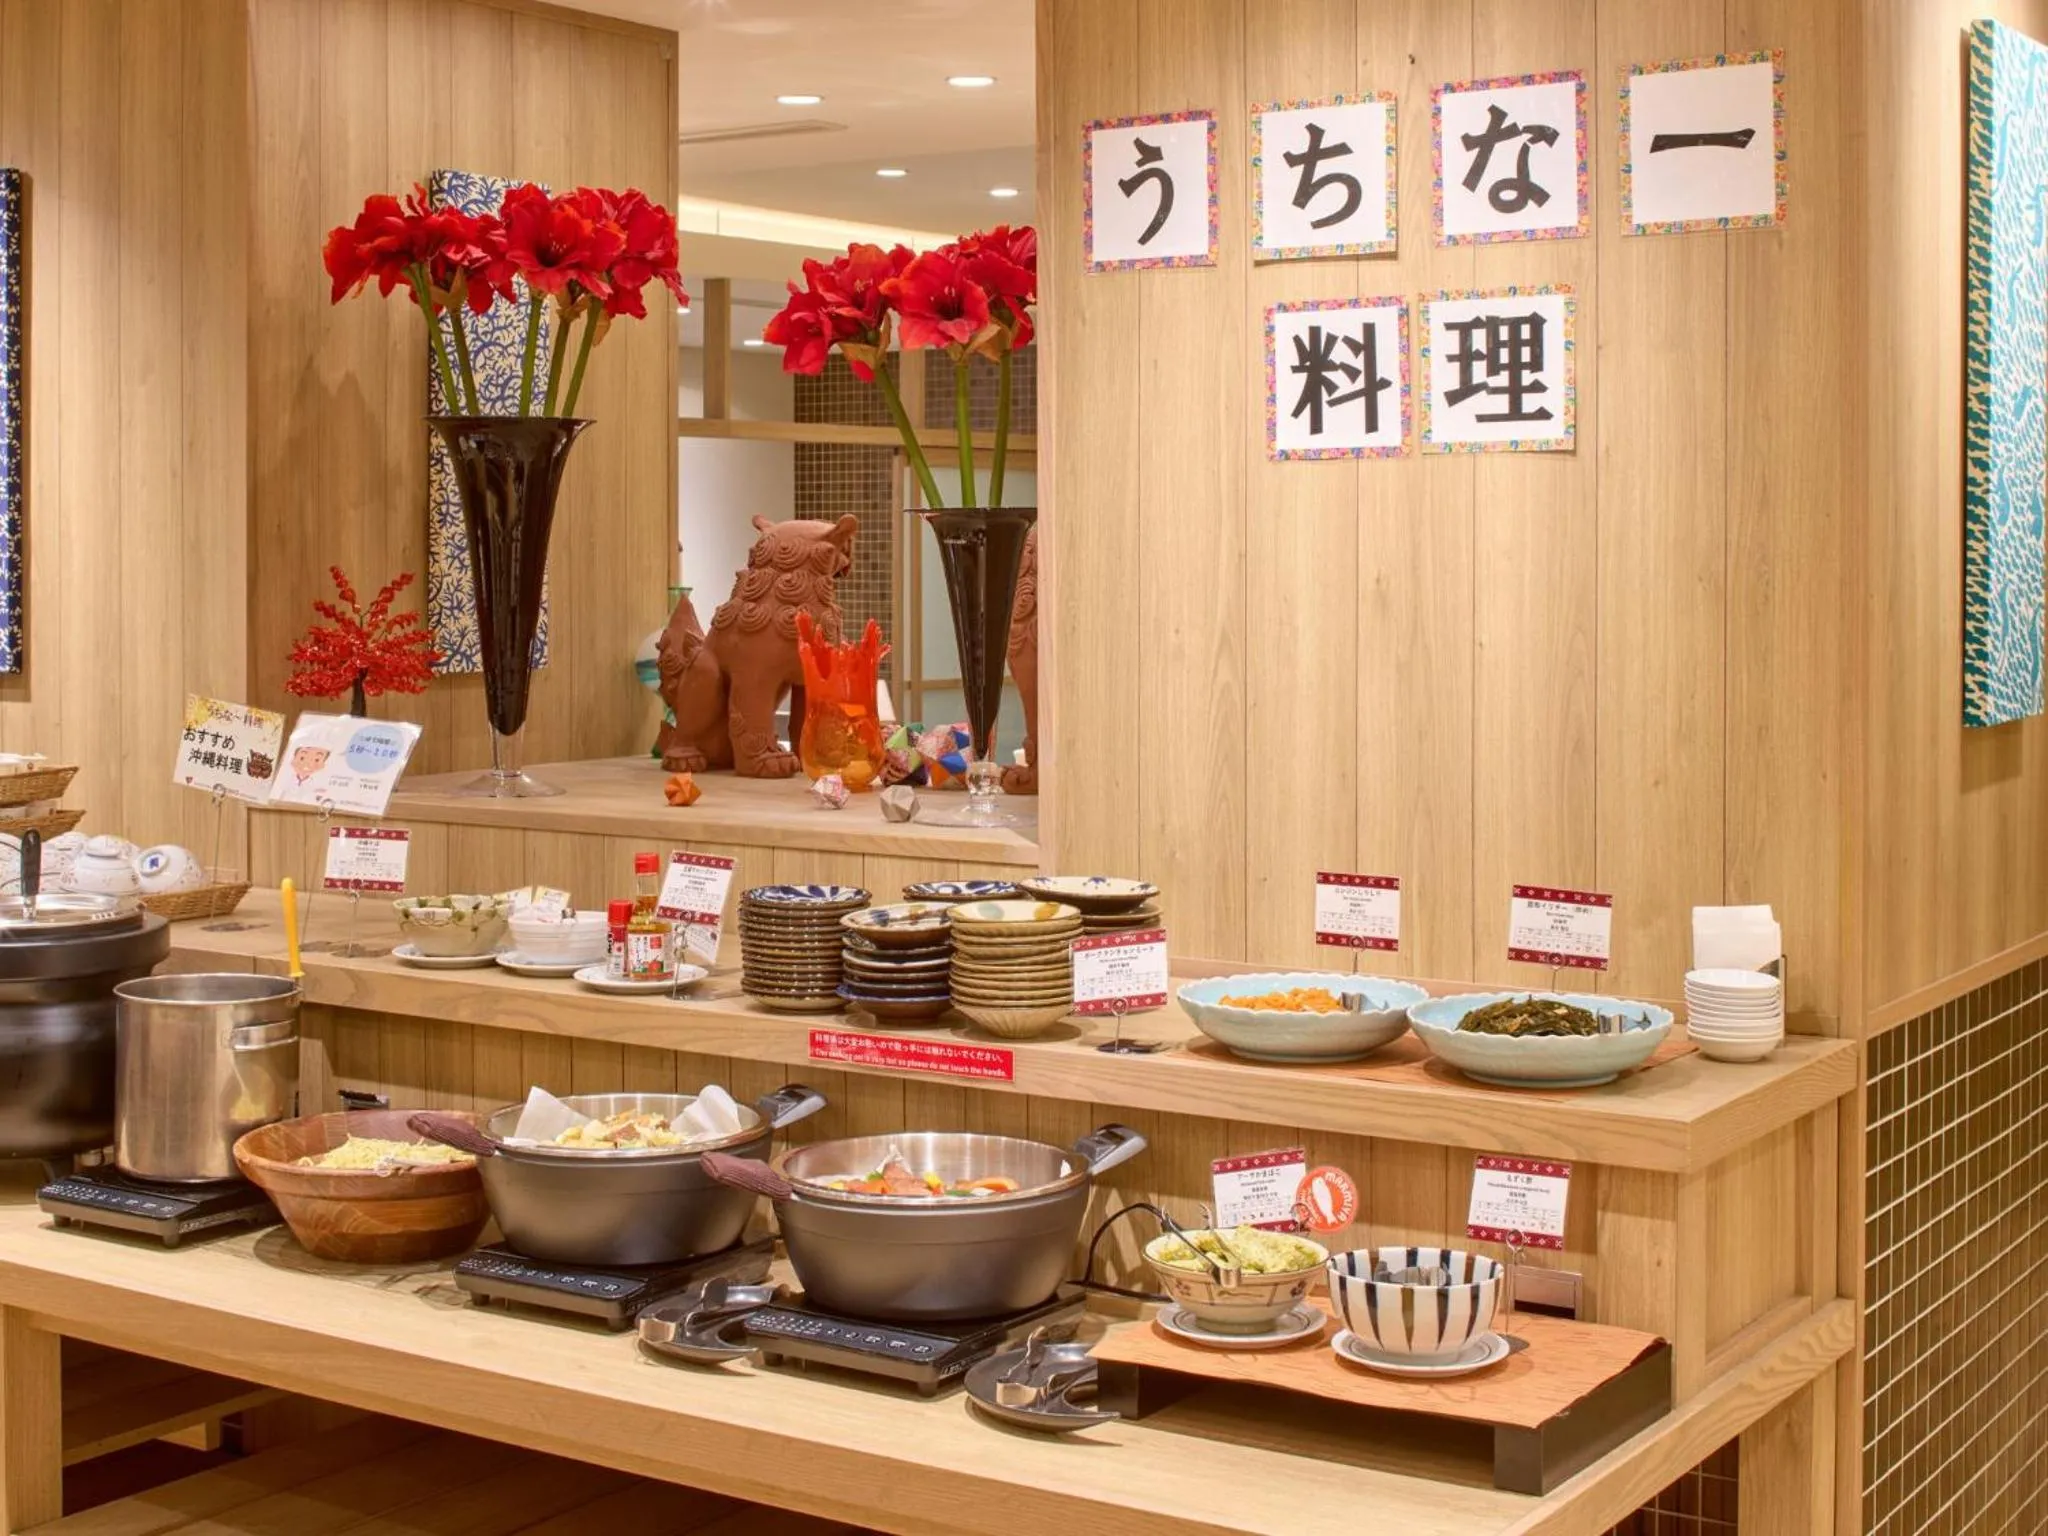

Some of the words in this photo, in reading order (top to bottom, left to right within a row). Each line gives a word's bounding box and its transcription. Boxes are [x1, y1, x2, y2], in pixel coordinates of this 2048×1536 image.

[1290, 312, 1554, 436] 料理
[183, 726, 236, 751] おすすめ
[188, 748, 243, 775] 沖縄料理
